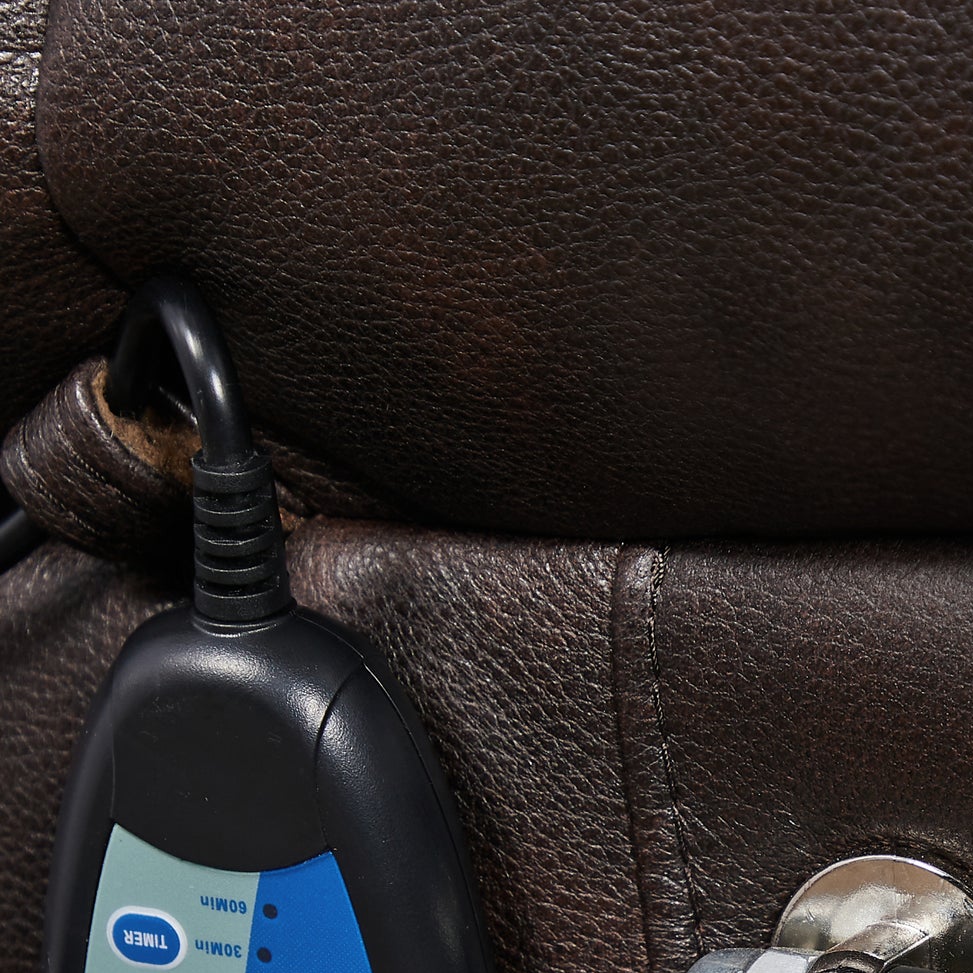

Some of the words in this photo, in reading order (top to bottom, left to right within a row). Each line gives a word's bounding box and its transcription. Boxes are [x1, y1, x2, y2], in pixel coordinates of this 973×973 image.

[200, 895, 247, 914] 60Min
[123, 929, 168, 950] TIMER
[195, 939, 242, 958] 30Min
